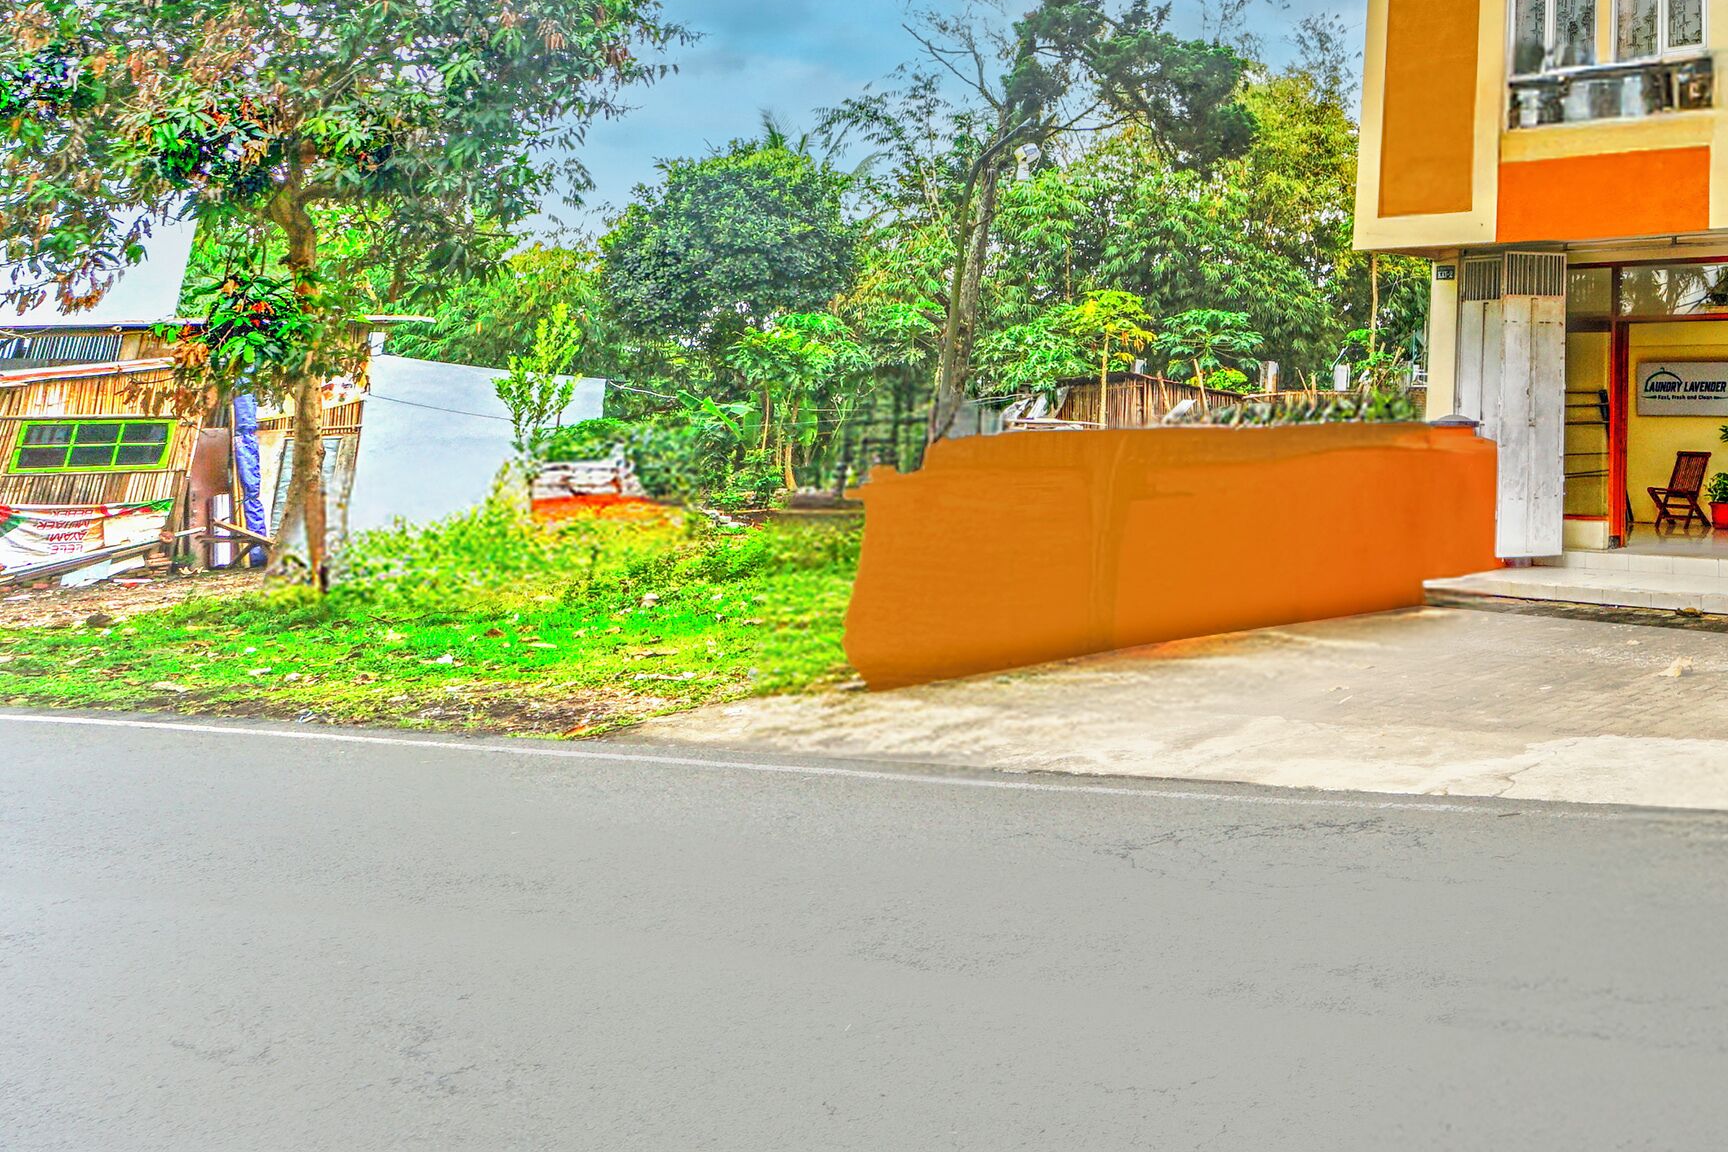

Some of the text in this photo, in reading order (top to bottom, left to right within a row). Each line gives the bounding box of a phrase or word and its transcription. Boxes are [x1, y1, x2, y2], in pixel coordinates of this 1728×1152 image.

[1644, 381, 1727, 392] LAUNDRY LAVENDER
[48, 531, 87, 542] AYAM
[50, 543, 83, 555] LELE
